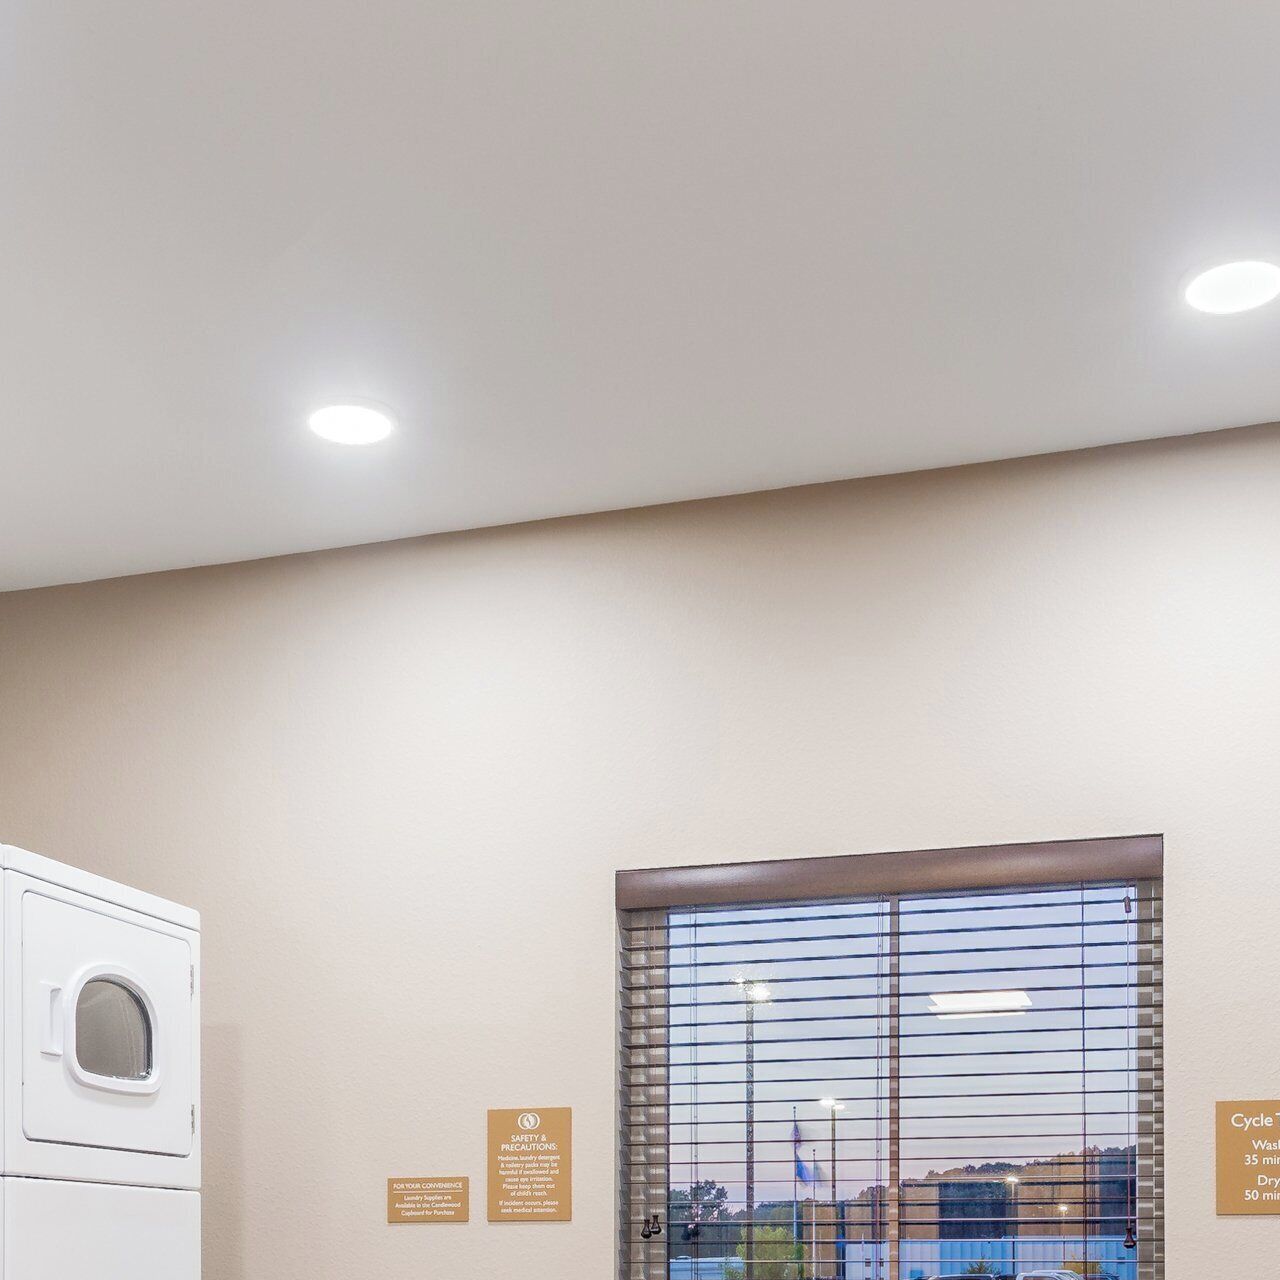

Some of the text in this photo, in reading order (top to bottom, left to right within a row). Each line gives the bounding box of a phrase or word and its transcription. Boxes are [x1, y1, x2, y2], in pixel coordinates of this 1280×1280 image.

[1231, 1113, 1273, 1131] Cycle
[510, 1134, 547, 1142] SAFETY &
[501, 1143, 558, 1151] PRECAUTIONS:
[1244, 1154, 1258, 1165] 35
[405, 1182, 421, 1190] YOUR
[421, 1182, 463, 1190] CONVENIENCE
[1244, 1190, 1259, 1201] 50
